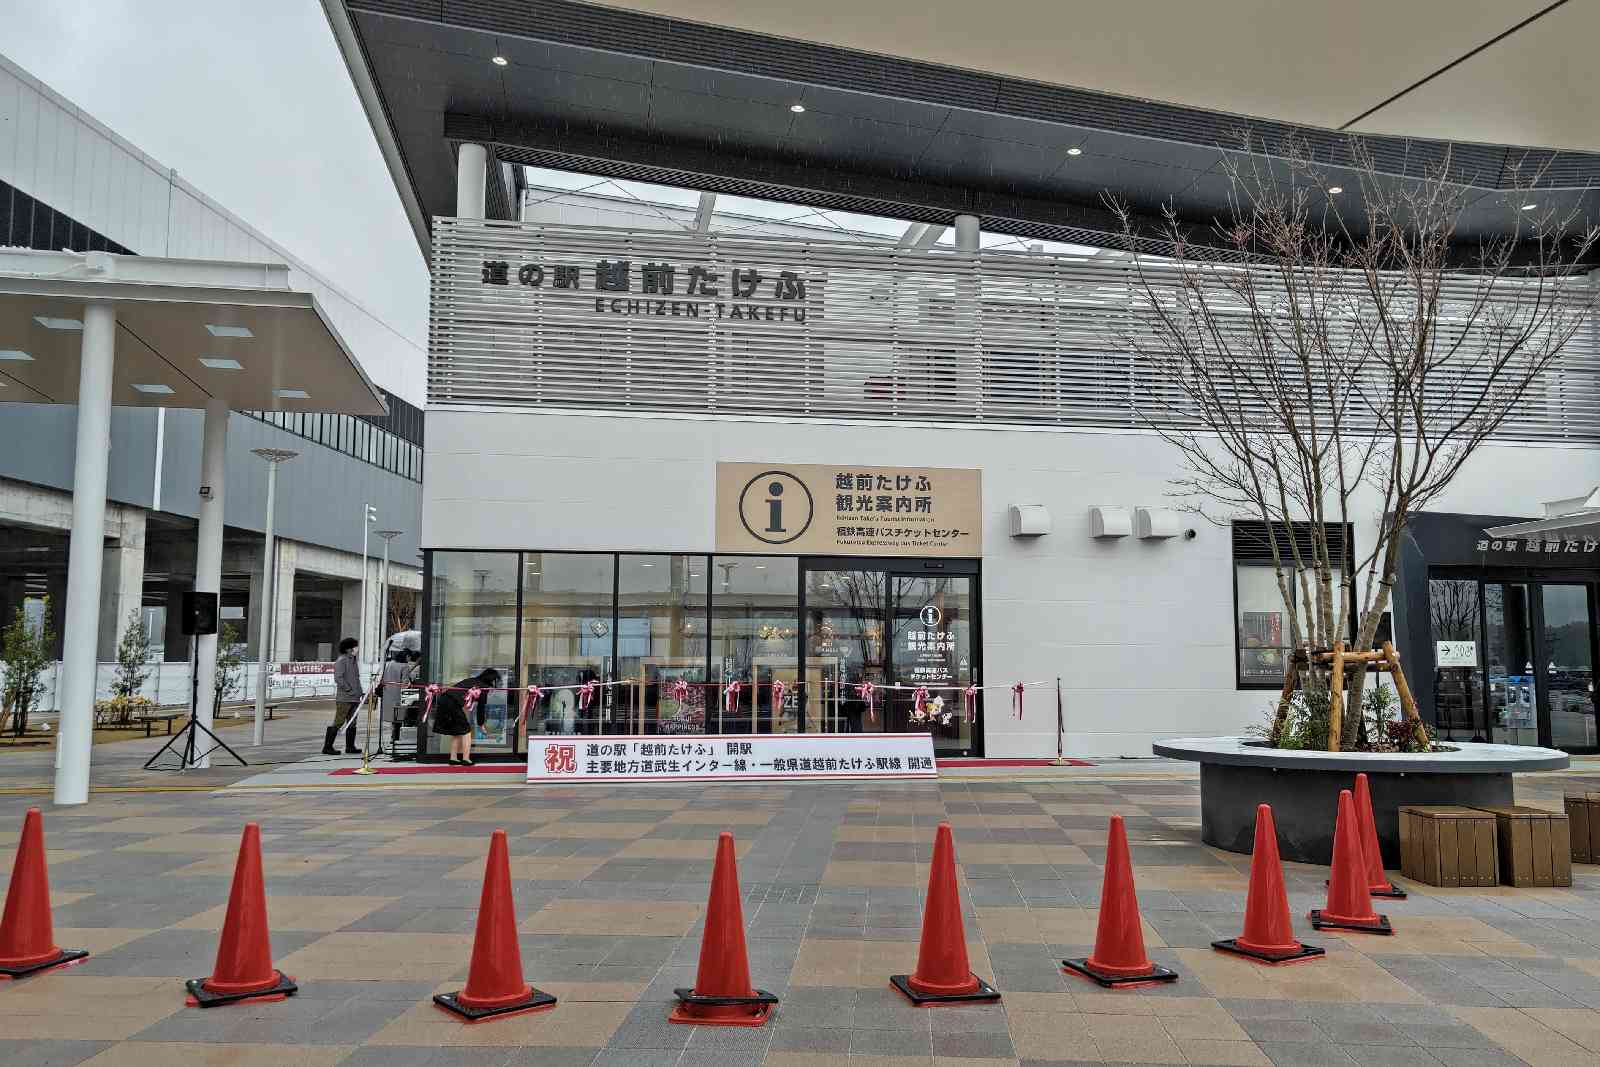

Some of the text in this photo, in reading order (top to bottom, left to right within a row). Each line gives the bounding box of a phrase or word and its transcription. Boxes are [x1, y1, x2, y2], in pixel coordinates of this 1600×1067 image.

[481, 259, 807, 300] 道の駅 越前たけふ
[835, 472, 933, 492] 越前たけふ
[835, 493, 933, 513] 観光案内所
[836, 526, 970, 538] 福鉄高速バスチケットセンター
[544, 743, 577, 773] 祝
